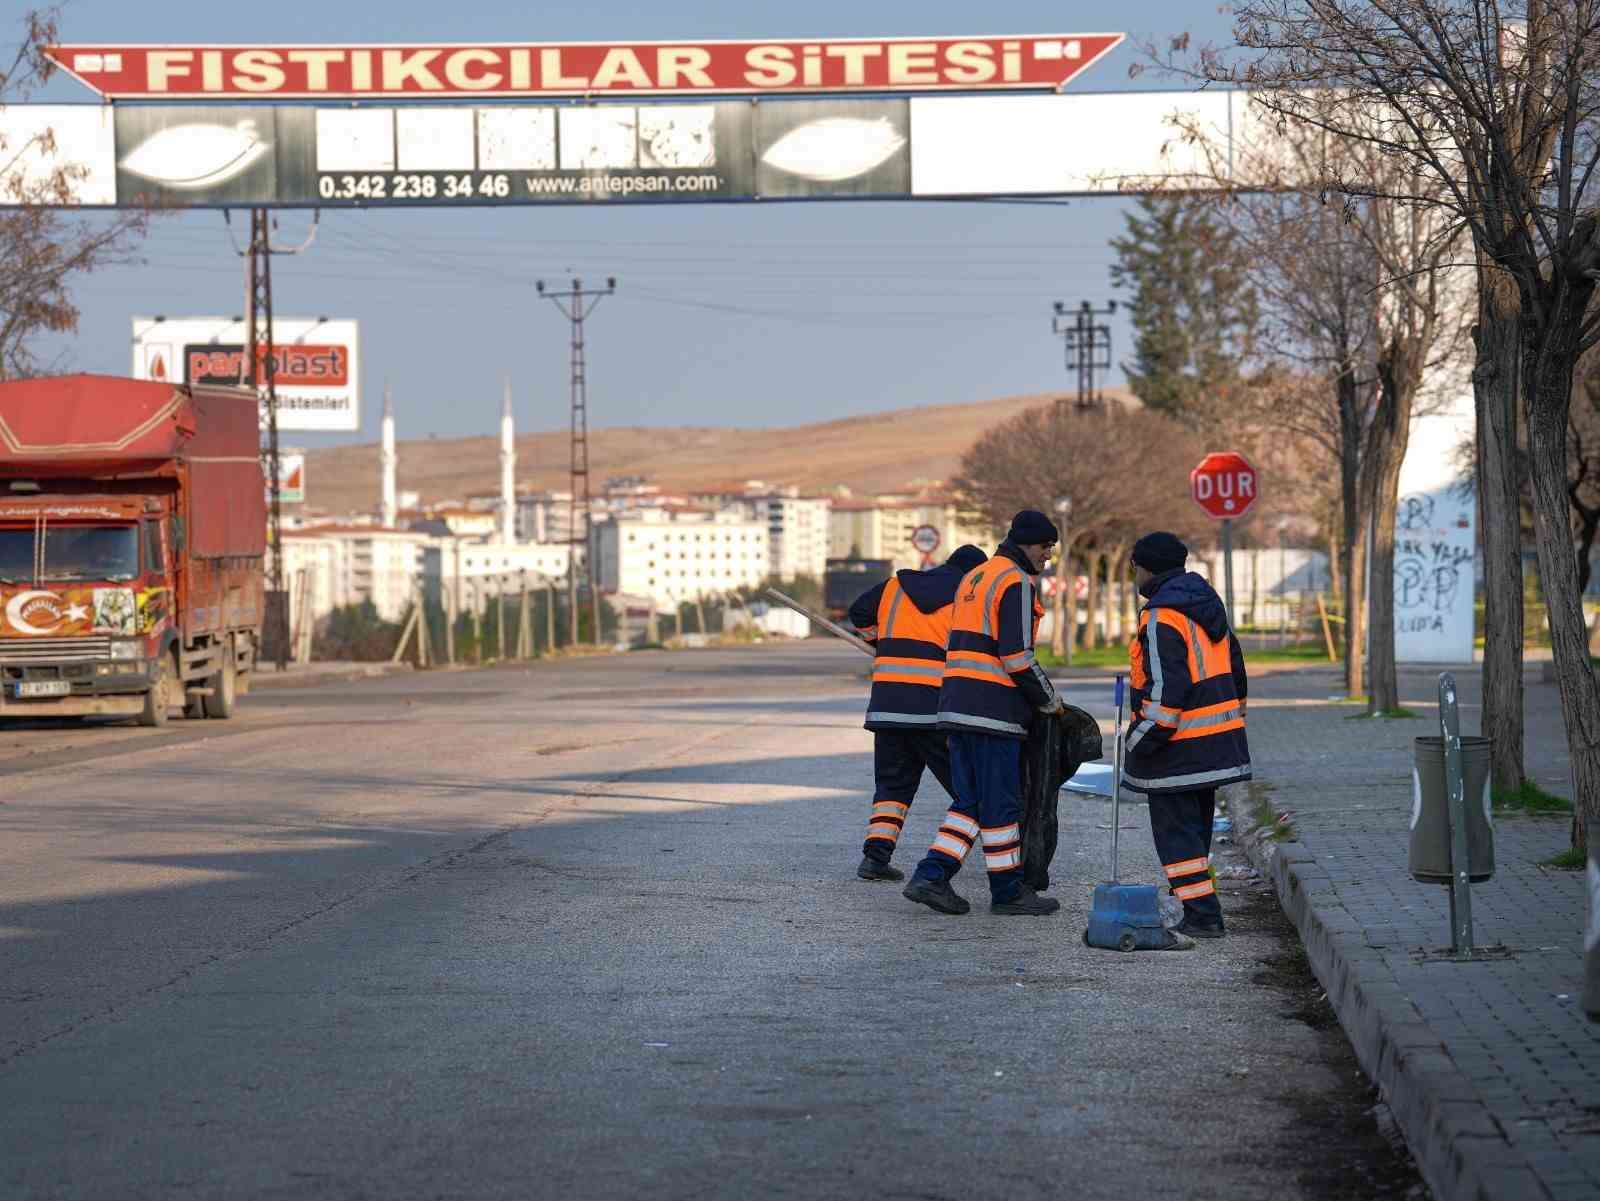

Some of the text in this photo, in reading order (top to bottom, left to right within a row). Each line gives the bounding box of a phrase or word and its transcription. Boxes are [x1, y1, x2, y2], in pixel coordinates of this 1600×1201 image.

[146, 48, 714, 91] FISTIKCILAR
[319, 174, 510, 198] 0.342 238 34 46
[526, 174, 718, 196] www.antepsan.com
[1196, 471, 1253, 499] DUR
